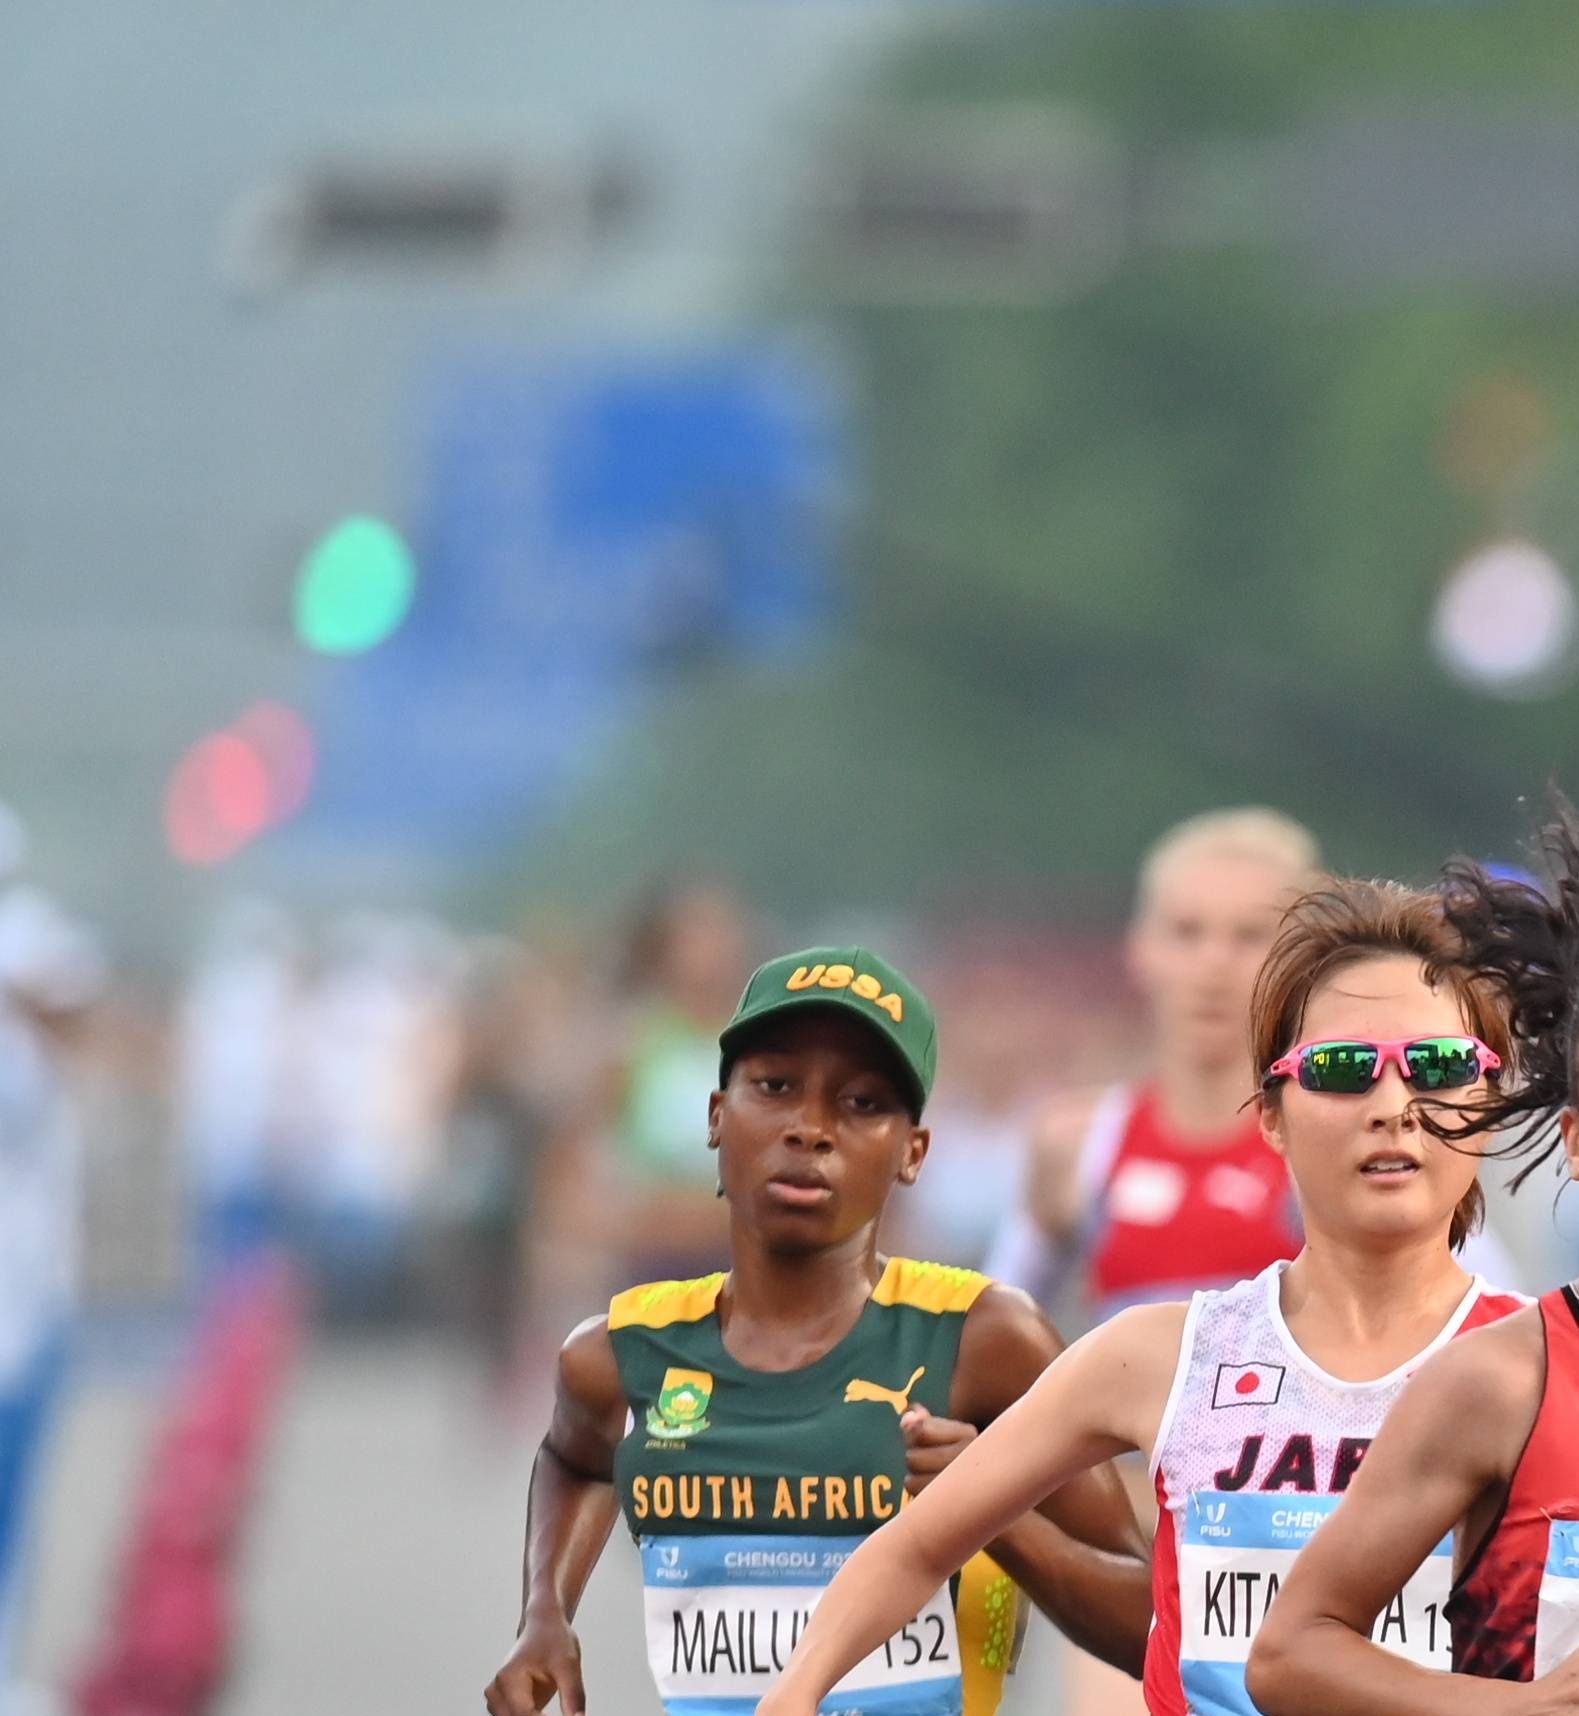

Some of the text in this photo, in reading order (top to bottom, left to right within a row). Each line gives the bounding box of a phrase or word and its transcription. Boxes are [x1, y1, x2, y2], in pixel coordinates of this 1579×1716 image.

[786, 964, 902, 1023] USSA
[1214, 1434, 1374, 1493] JAP
[633, 1475, 754, 1519] SOUTH
[1199, 1526, 1231, 1538] FISU
[1271, 1510, 1329, 1527] CHEN
[656, 1568, 688, 1579] FISU
[724, 1551, 817, 1568] CHENGDU
[672, 1609, 949, 1674] MAILU 152
